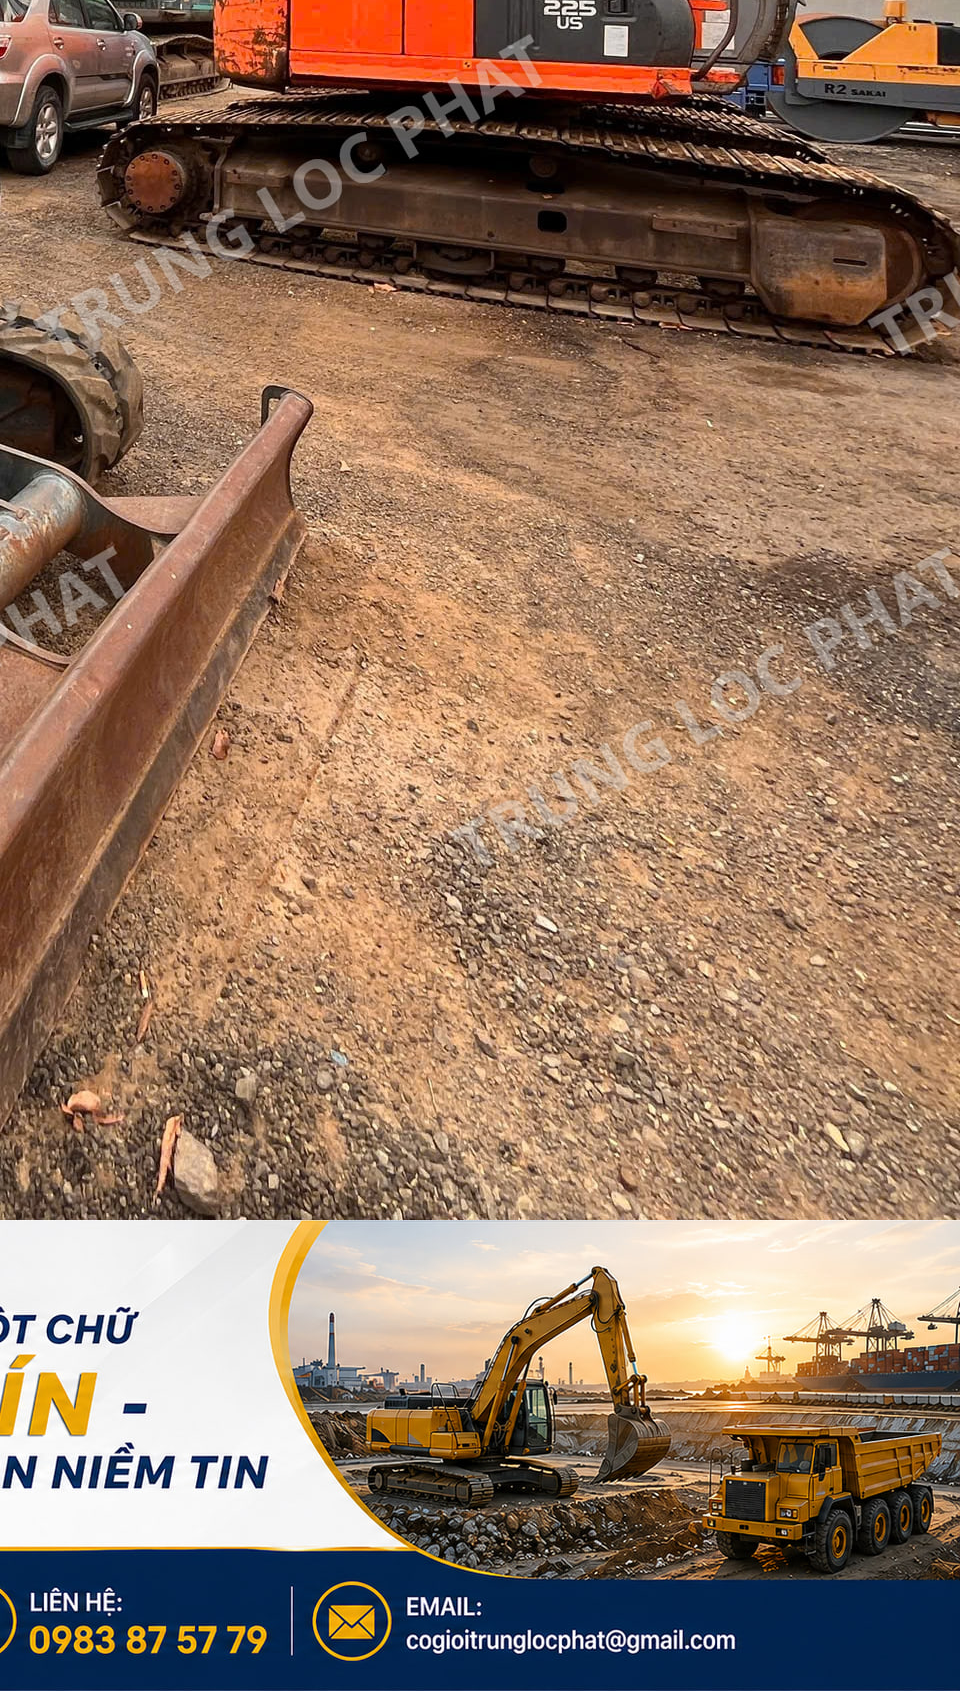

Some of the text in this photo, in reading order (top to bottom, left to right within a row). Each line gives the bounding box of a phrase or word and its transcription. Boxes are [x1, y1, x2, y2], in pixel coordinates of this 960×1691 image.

[543, 0, 597, 16] 225
[557, 16, 583, 29] US
[824, 83, 886, 97] R2 SAKAI
